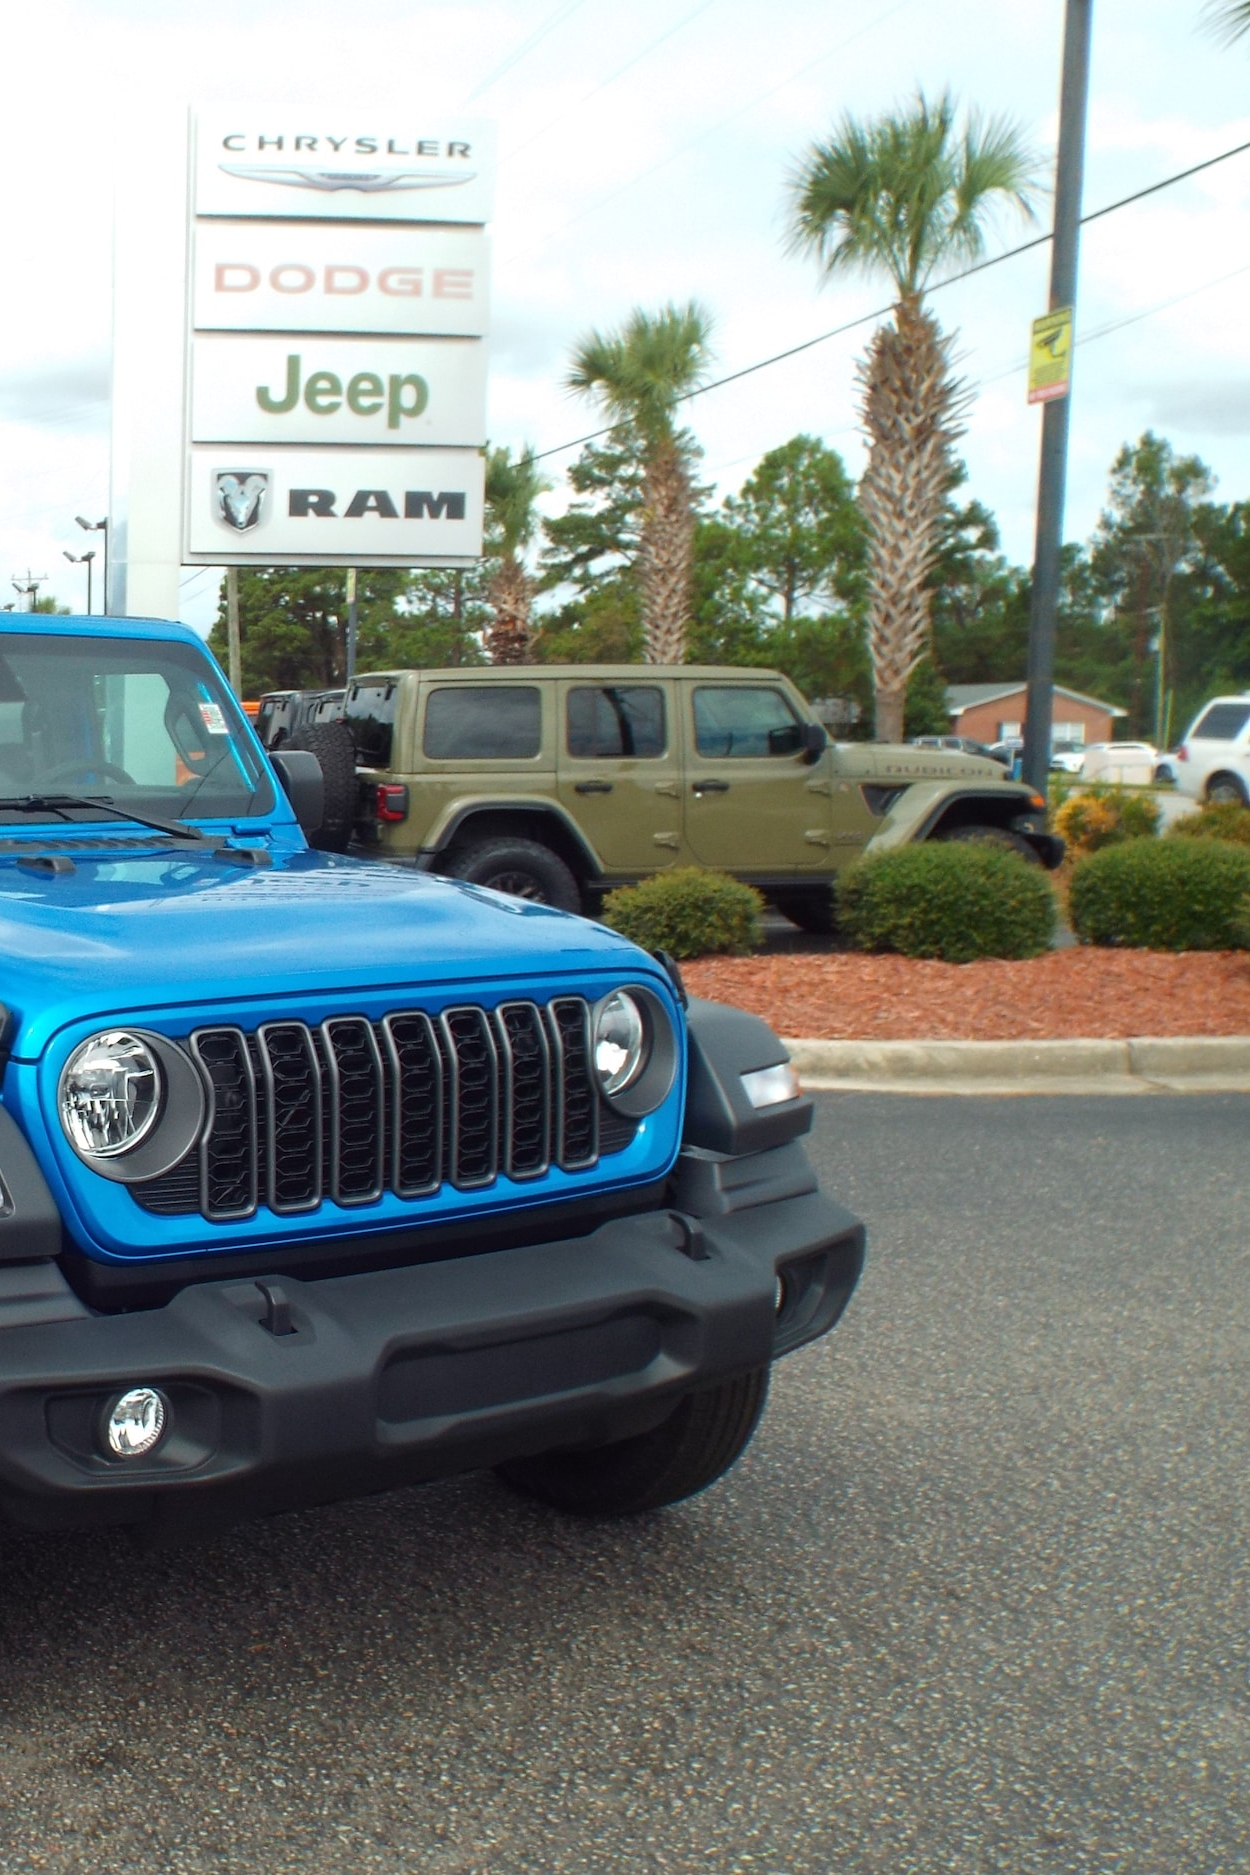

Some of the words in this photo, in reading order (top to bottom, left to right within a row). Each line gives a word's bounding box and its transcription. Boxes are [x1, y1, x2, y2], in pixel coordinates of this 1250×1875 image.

[222, 133, 472, 159] CHRYSLER
[214, 263, 473, 300] DODGE
[256, 354, 429, 430] Jeep
[288, 488, 466, 521] RAM
[885, 765, 993, 777] RUBICON
